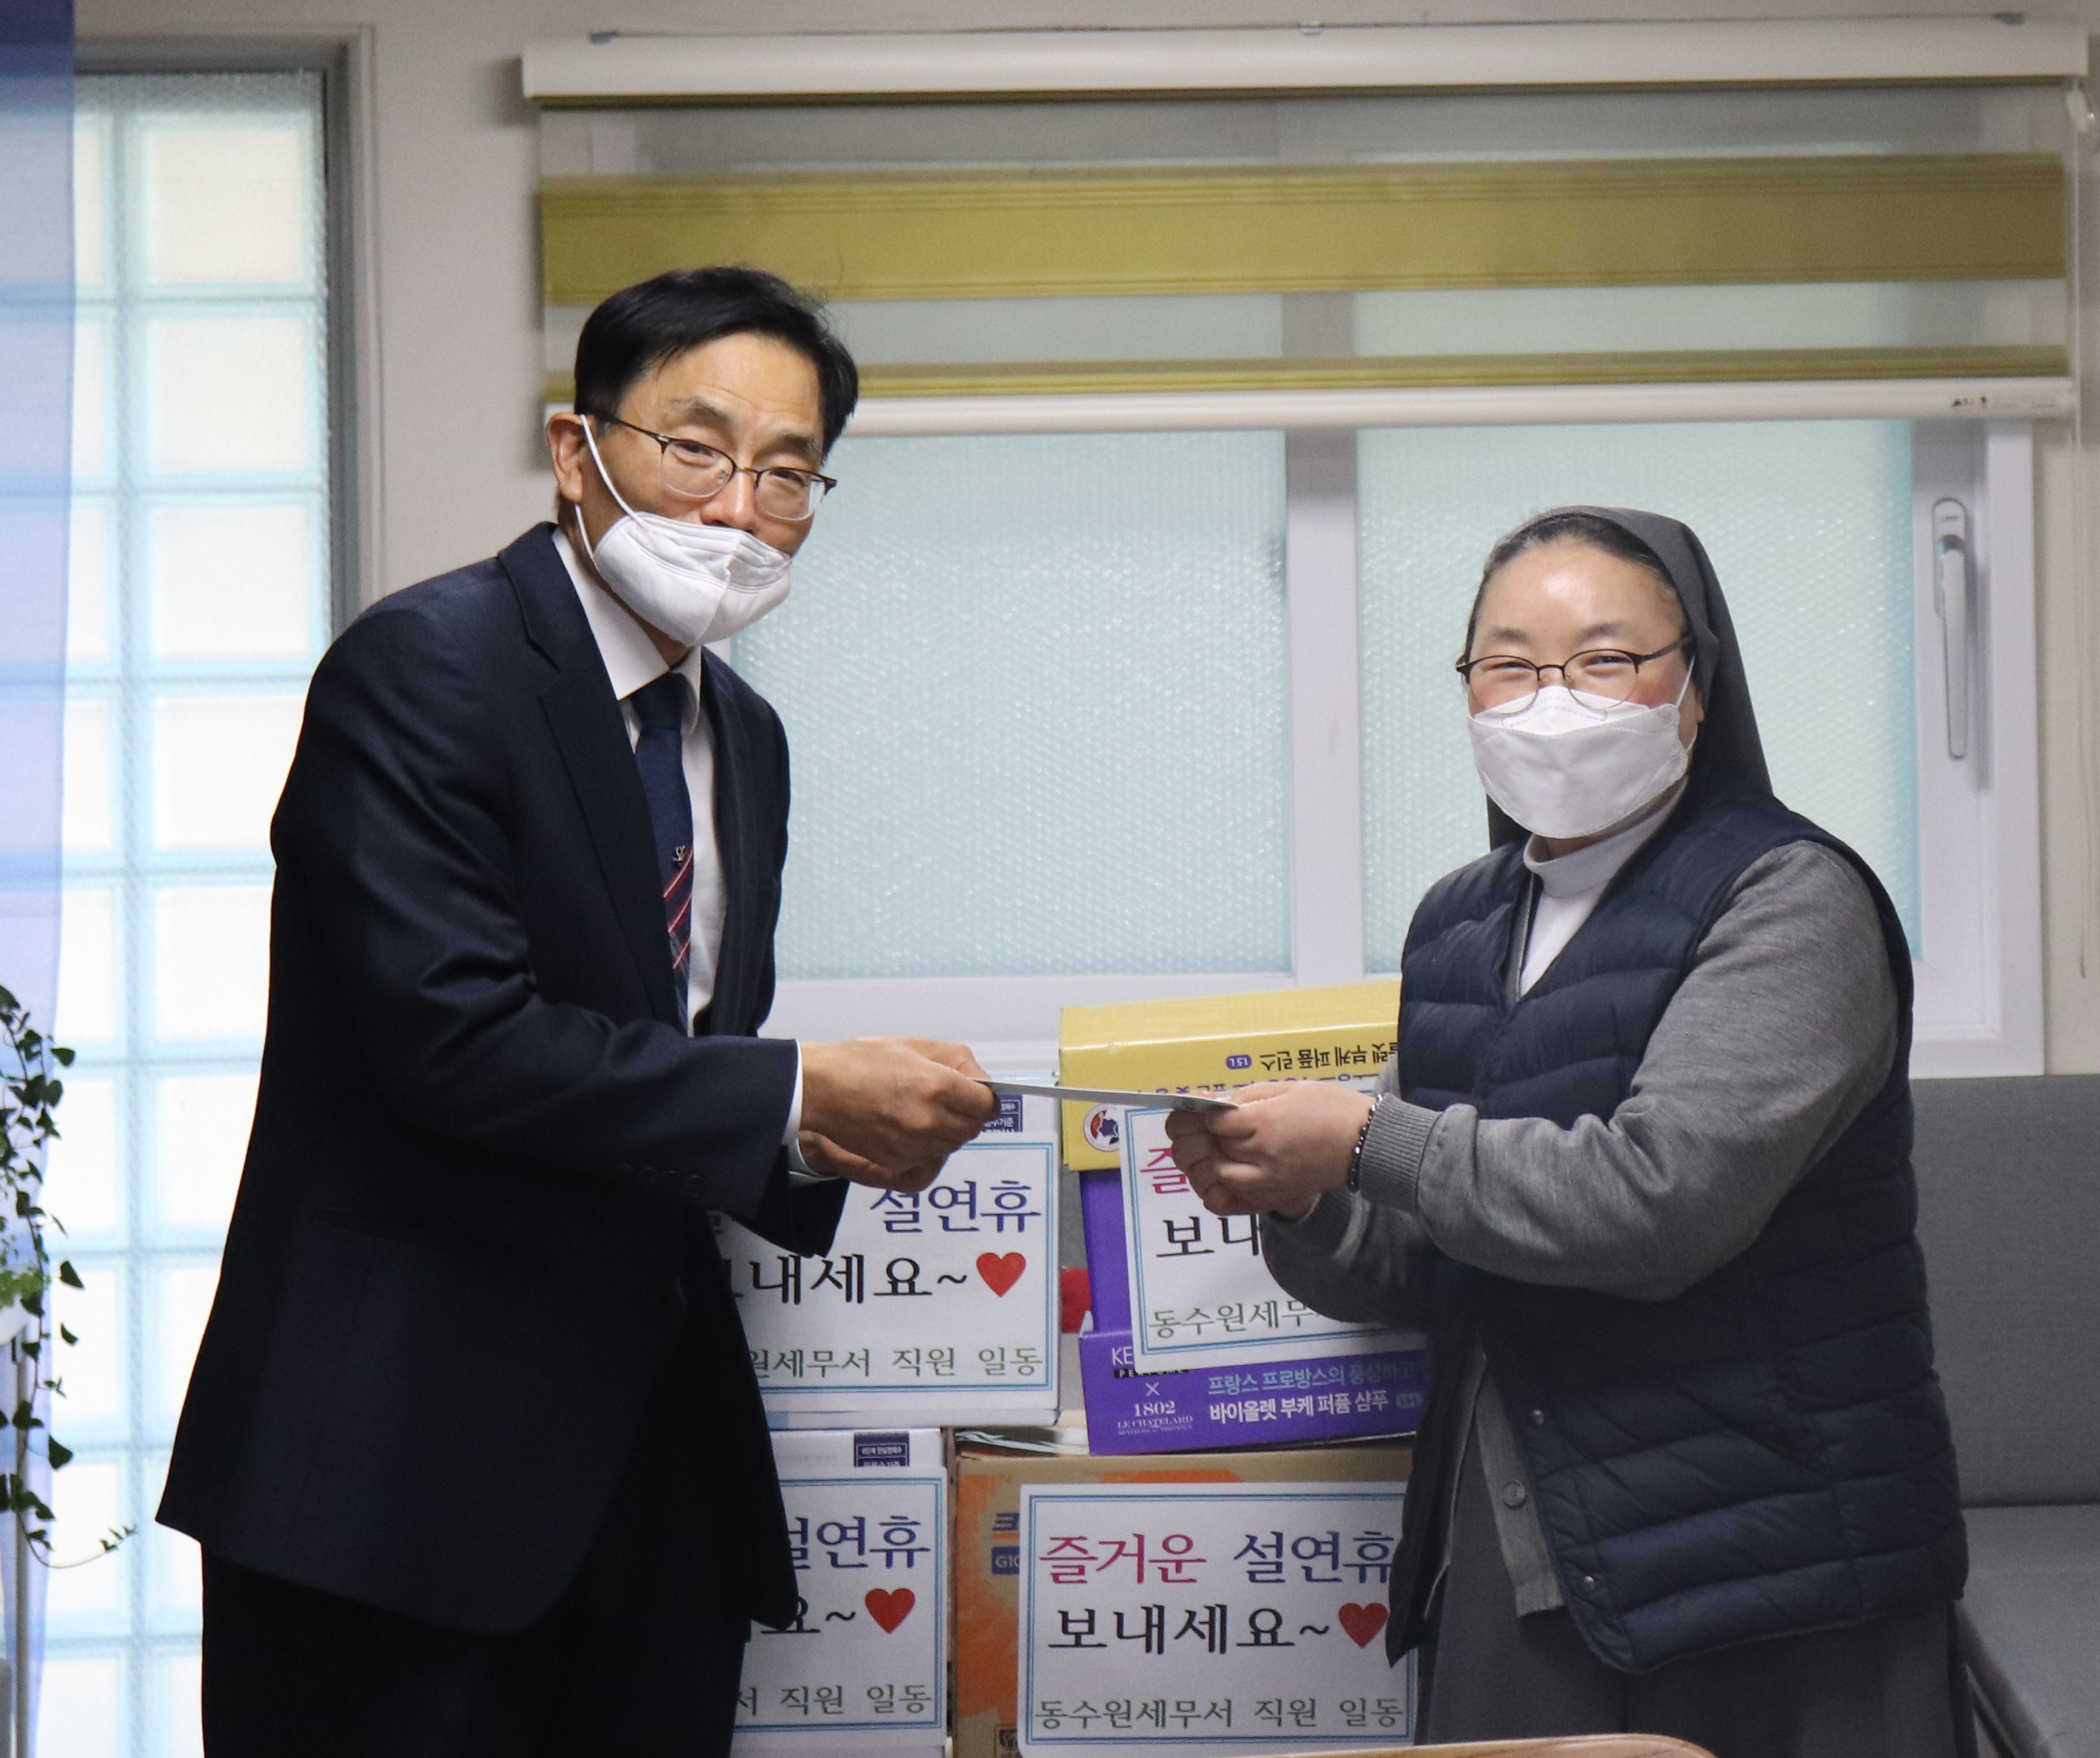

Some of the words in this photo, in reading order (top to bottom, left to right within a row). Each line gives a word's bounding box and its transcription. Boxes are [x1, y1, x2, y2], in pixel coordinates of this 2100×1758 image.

[1259, 1051, 1293, 1071] 린스
[1298, 1048, 1331, 1069] 퍼퓸
[1336, 1045, 1367, 1067] 부케
[870, 1181, 1041, 1233] 설연휴
[728, 1253, 967, 1304] 내세요~
[893, 1346, 956, 1377] 직원
[978, 1346, 1044, 1377] 일동
[1208, 1373, 1259, 1396] 프랑스
[1262, 1365, 1346, 1390] 프로방스의
[1134, 1400, 1176, 1417] 1802
[1209, 1398, 1277, 1424] 바이올렛
[1280, 1394, 1315, 1419] 부케
[1317, 1390, 1352, 1415] 퍼퓸
[1355, 1388, 1390, 1413] 샴푸
[1039, 1533, 1207, 1584] 즐거운
[1234, 1530, 1395, 1584] 설연휴
[781, 1684, 844, 1715] 직원
[867, 1683, 931, 1714] 일동
[1035, 1698, 1233, 1730] 동수원세무서
[1254, 1697, 1317, 1728] 직원
[1339, 1697, 1405, 1728] 일동
